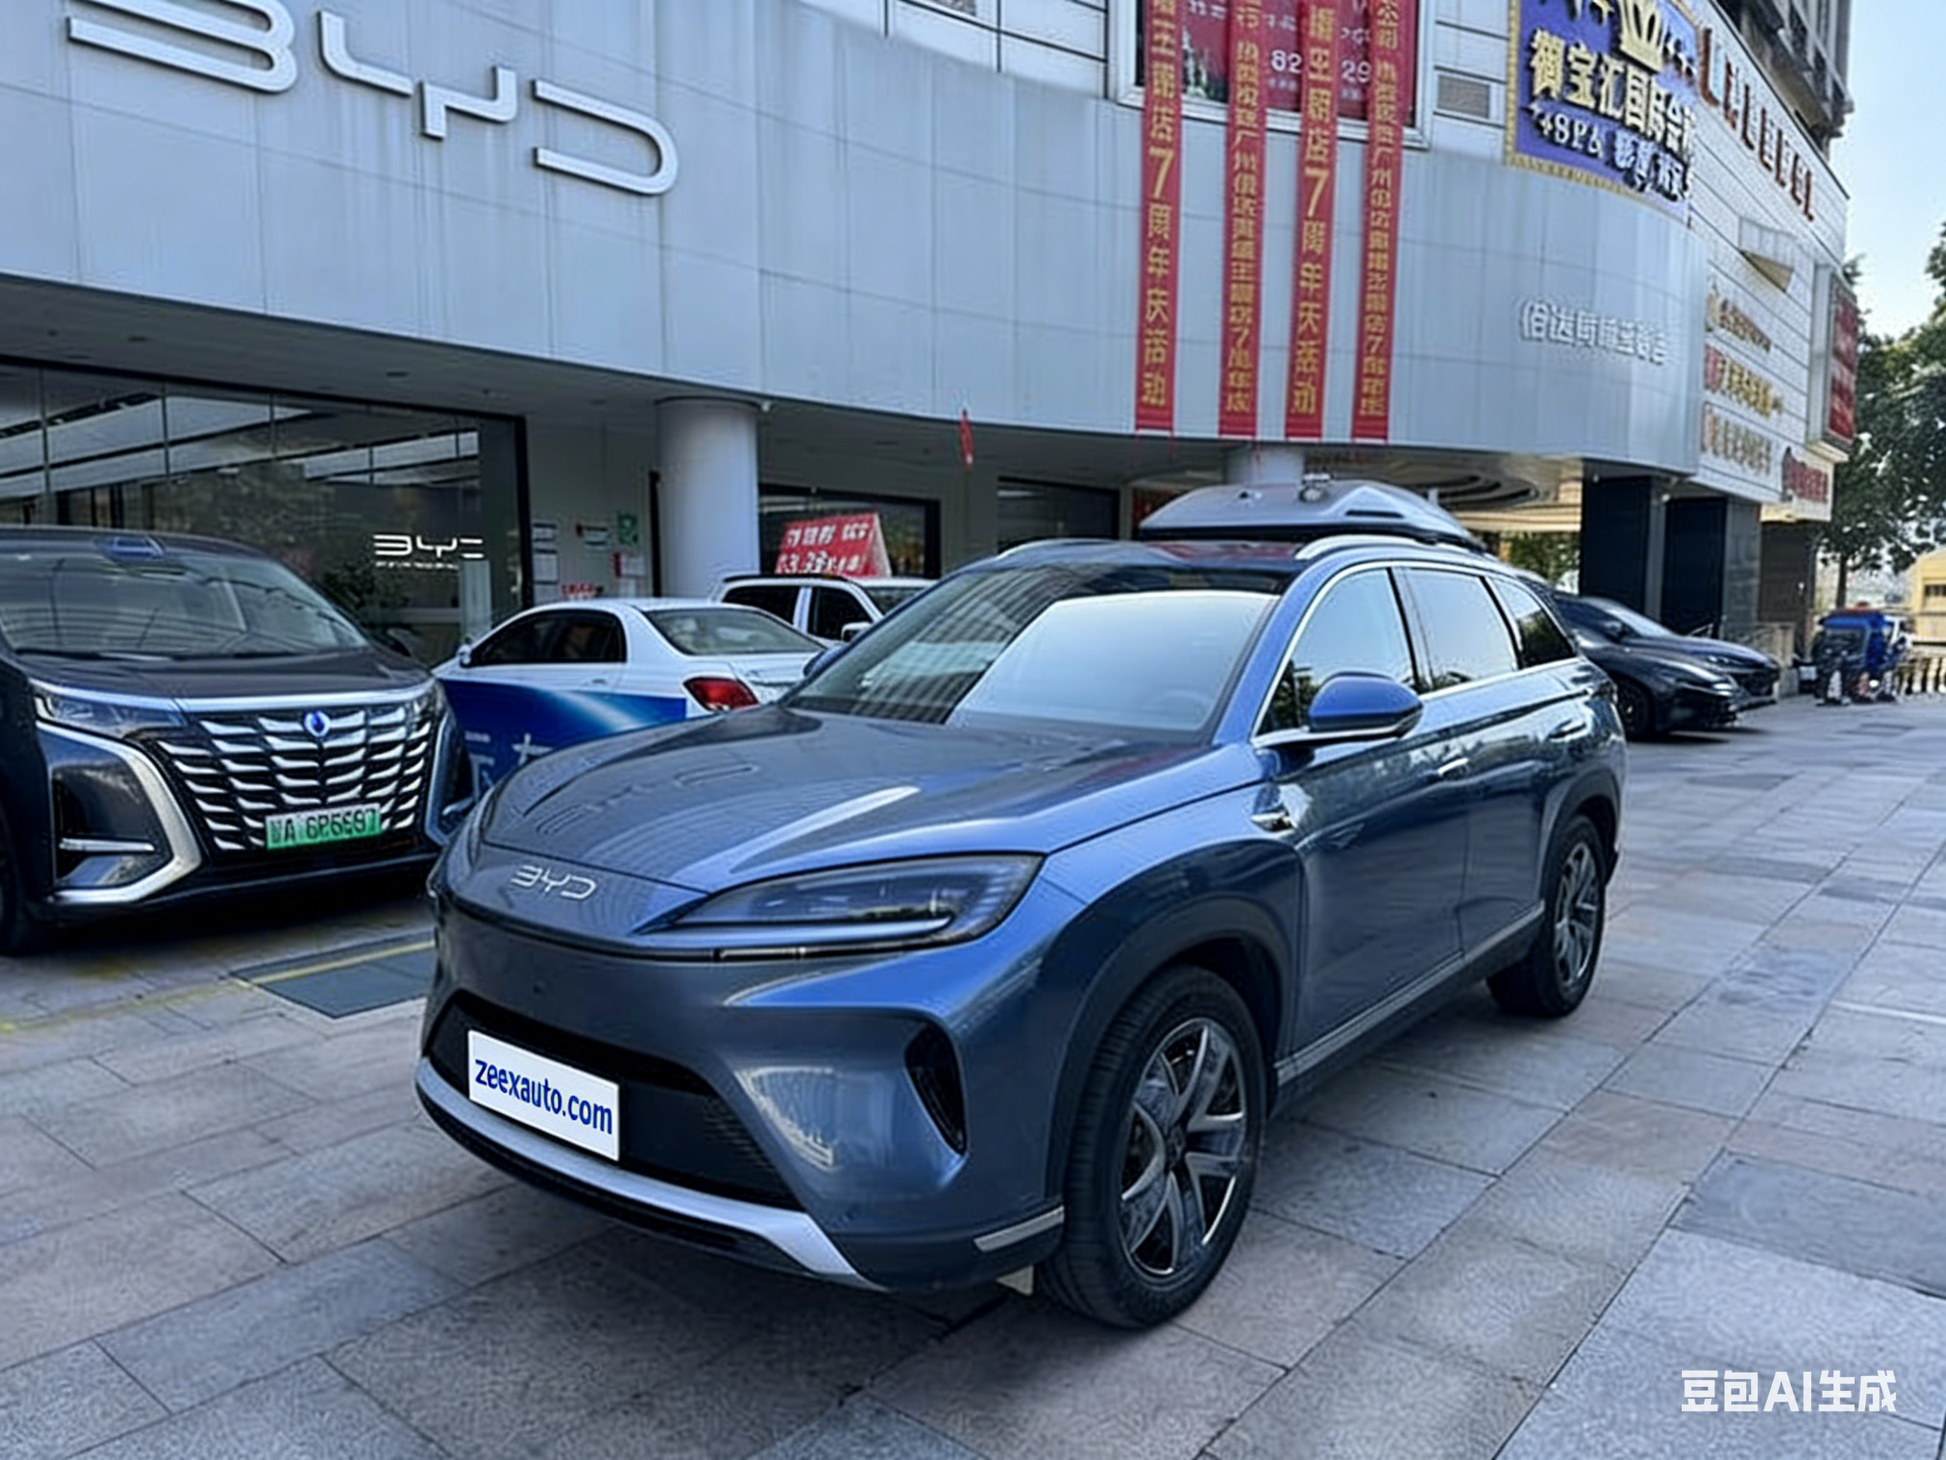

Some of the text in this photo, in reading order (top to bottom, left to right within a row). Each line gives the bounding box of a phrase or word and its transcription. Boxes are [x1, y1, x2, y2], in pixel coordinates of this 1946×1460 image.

[1270, 49, 1303, 73] 82
[66, 0, 680, 197] BYD
[510, 864, 597, 900] BYD
[475, 1059, 613, 1135] zeexauto.com
